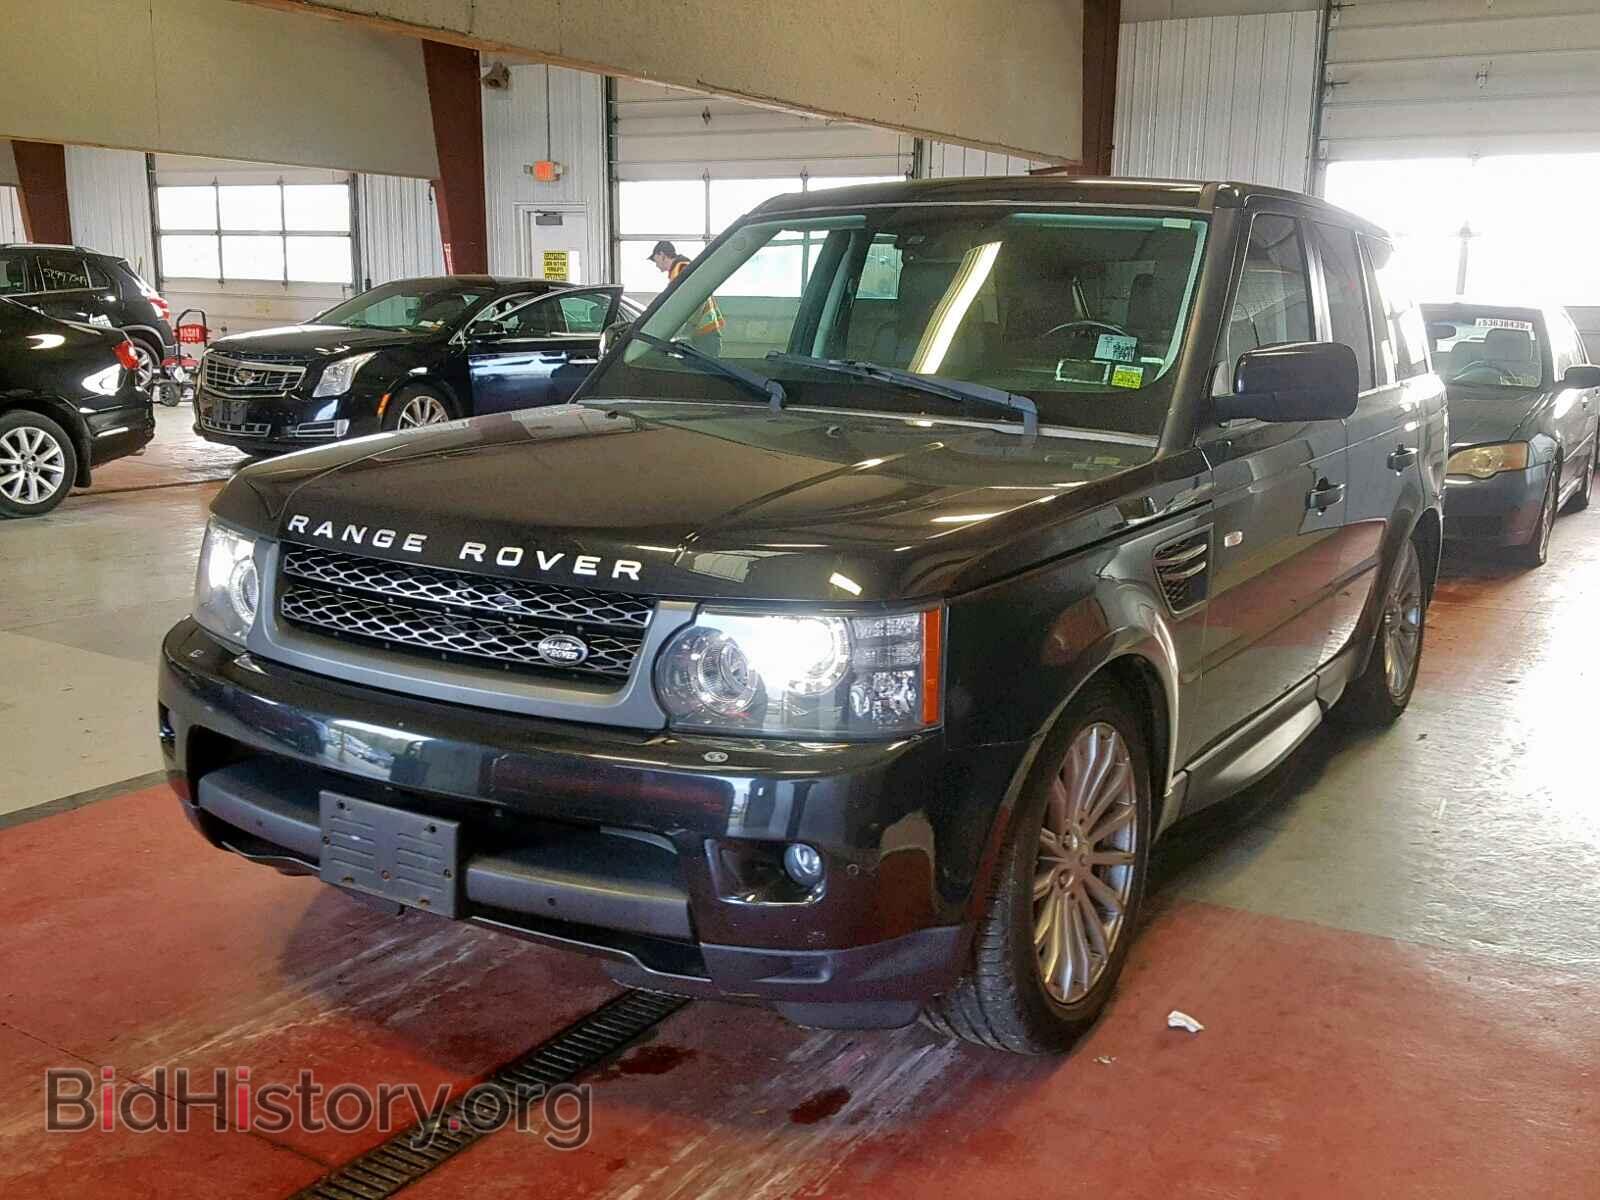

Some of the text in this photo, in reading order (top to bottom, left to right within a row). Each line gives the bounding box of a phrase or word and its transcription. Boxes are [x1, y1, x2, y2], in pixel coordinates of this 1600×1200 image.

[287, 514, 644, 582] RANGE ROVER
[549, 641, 572, 651] LAND
[550, 649, 577, 660] ROVER
